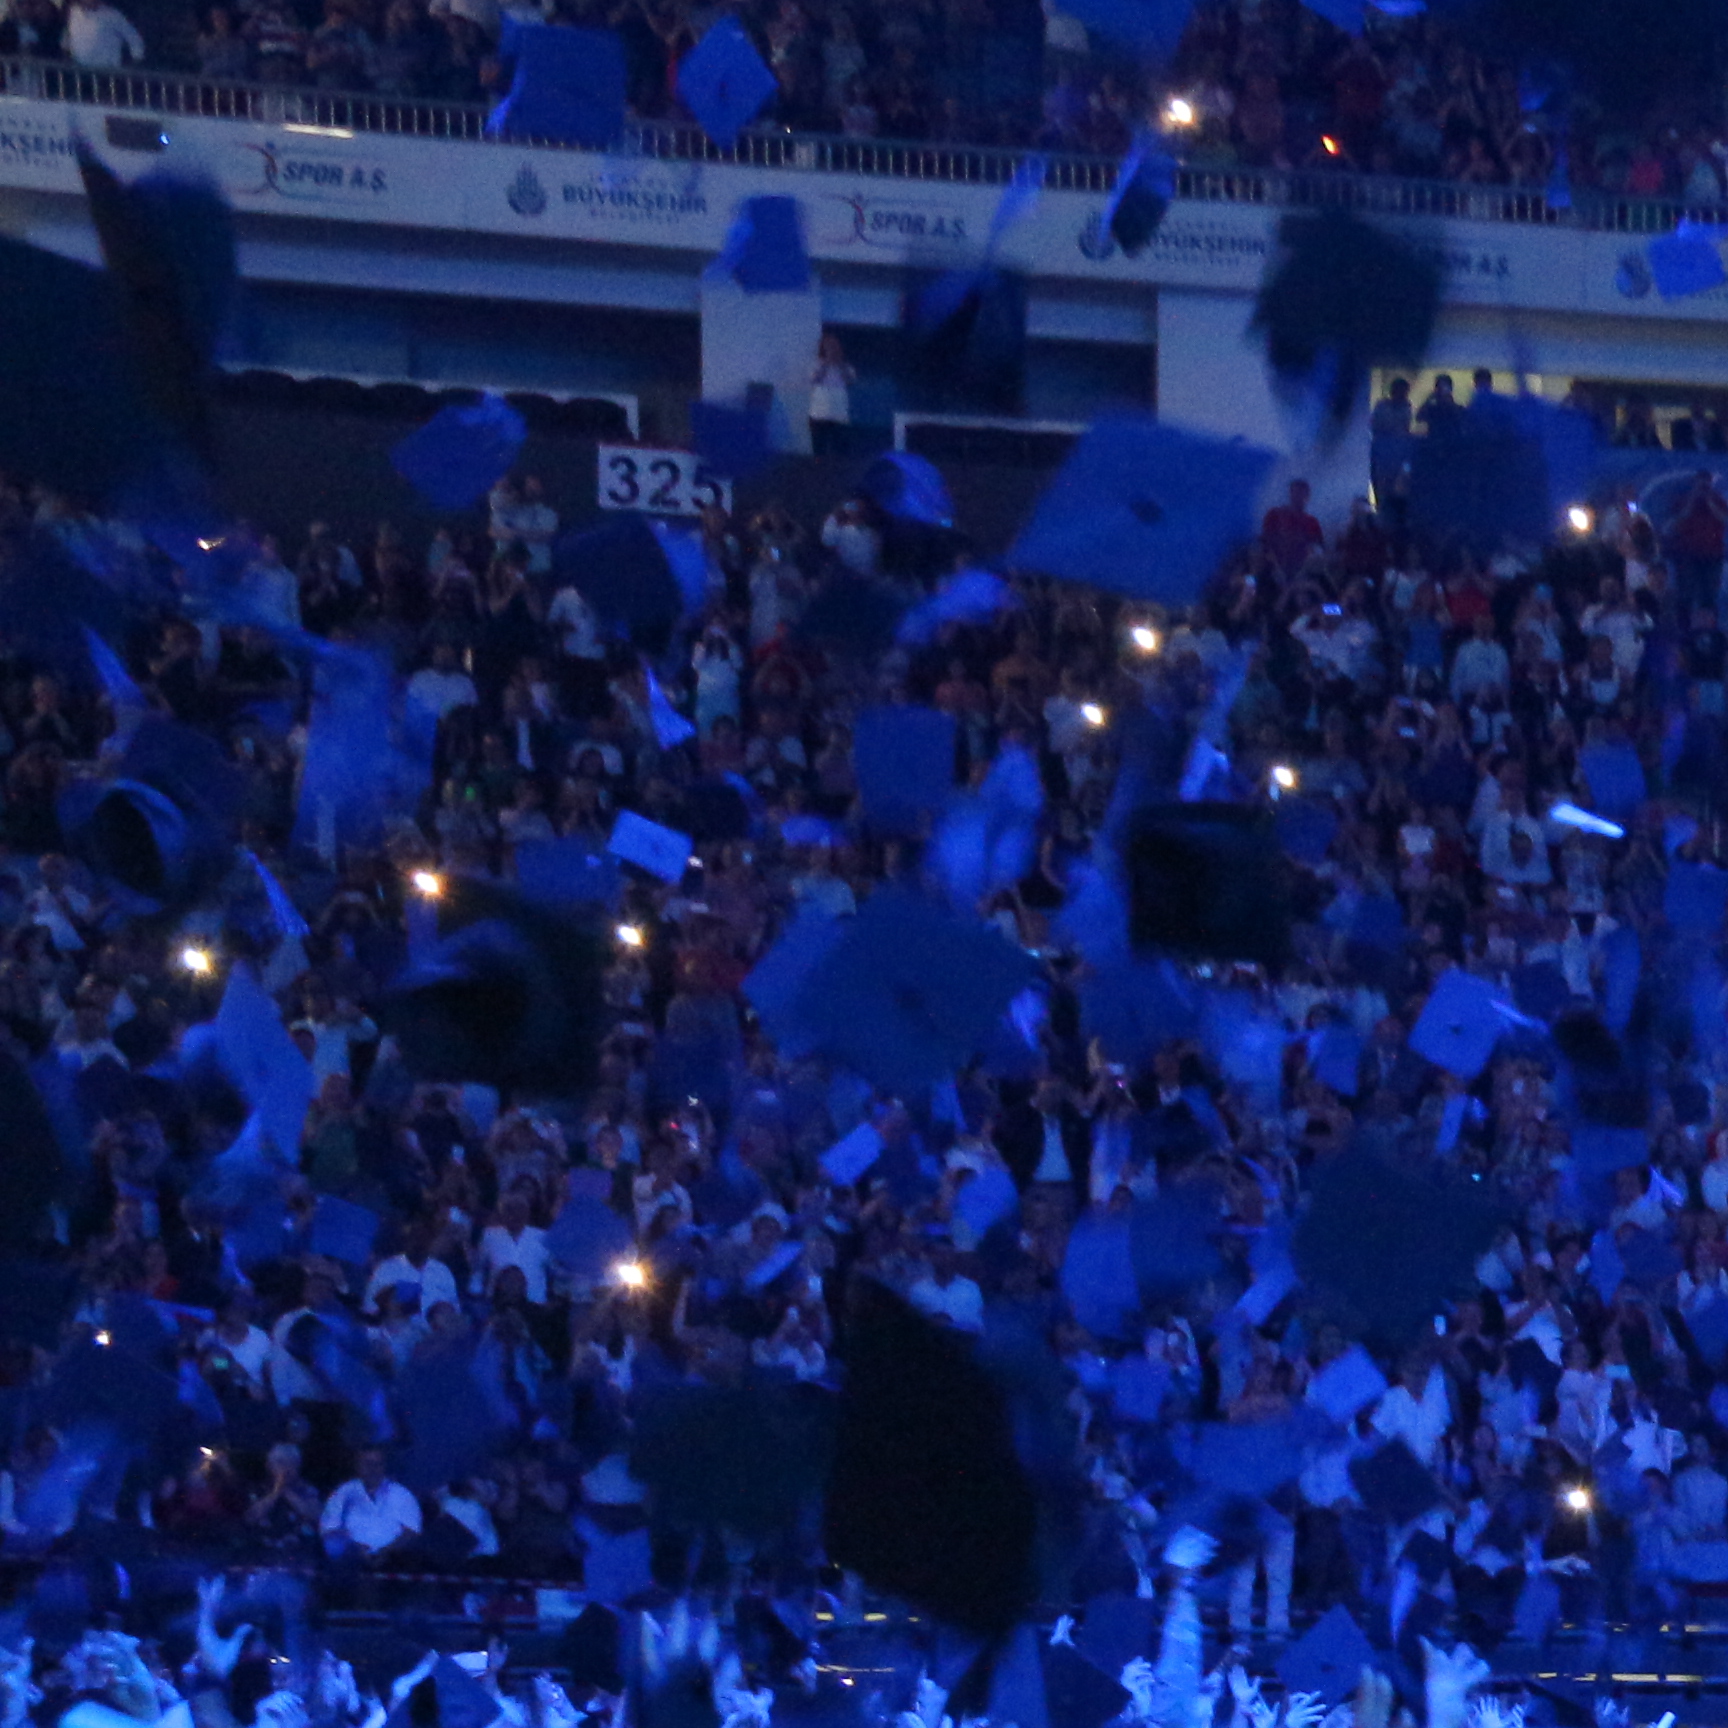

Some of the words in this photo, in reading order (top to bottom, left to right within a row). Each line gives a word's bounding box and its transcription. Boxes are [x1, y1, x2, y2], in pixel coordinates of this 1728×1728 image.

[282, 161, 343, 186] SPOR
[871, 210, 925, 235] SPOR
[607, 456, 724, 509] 325
